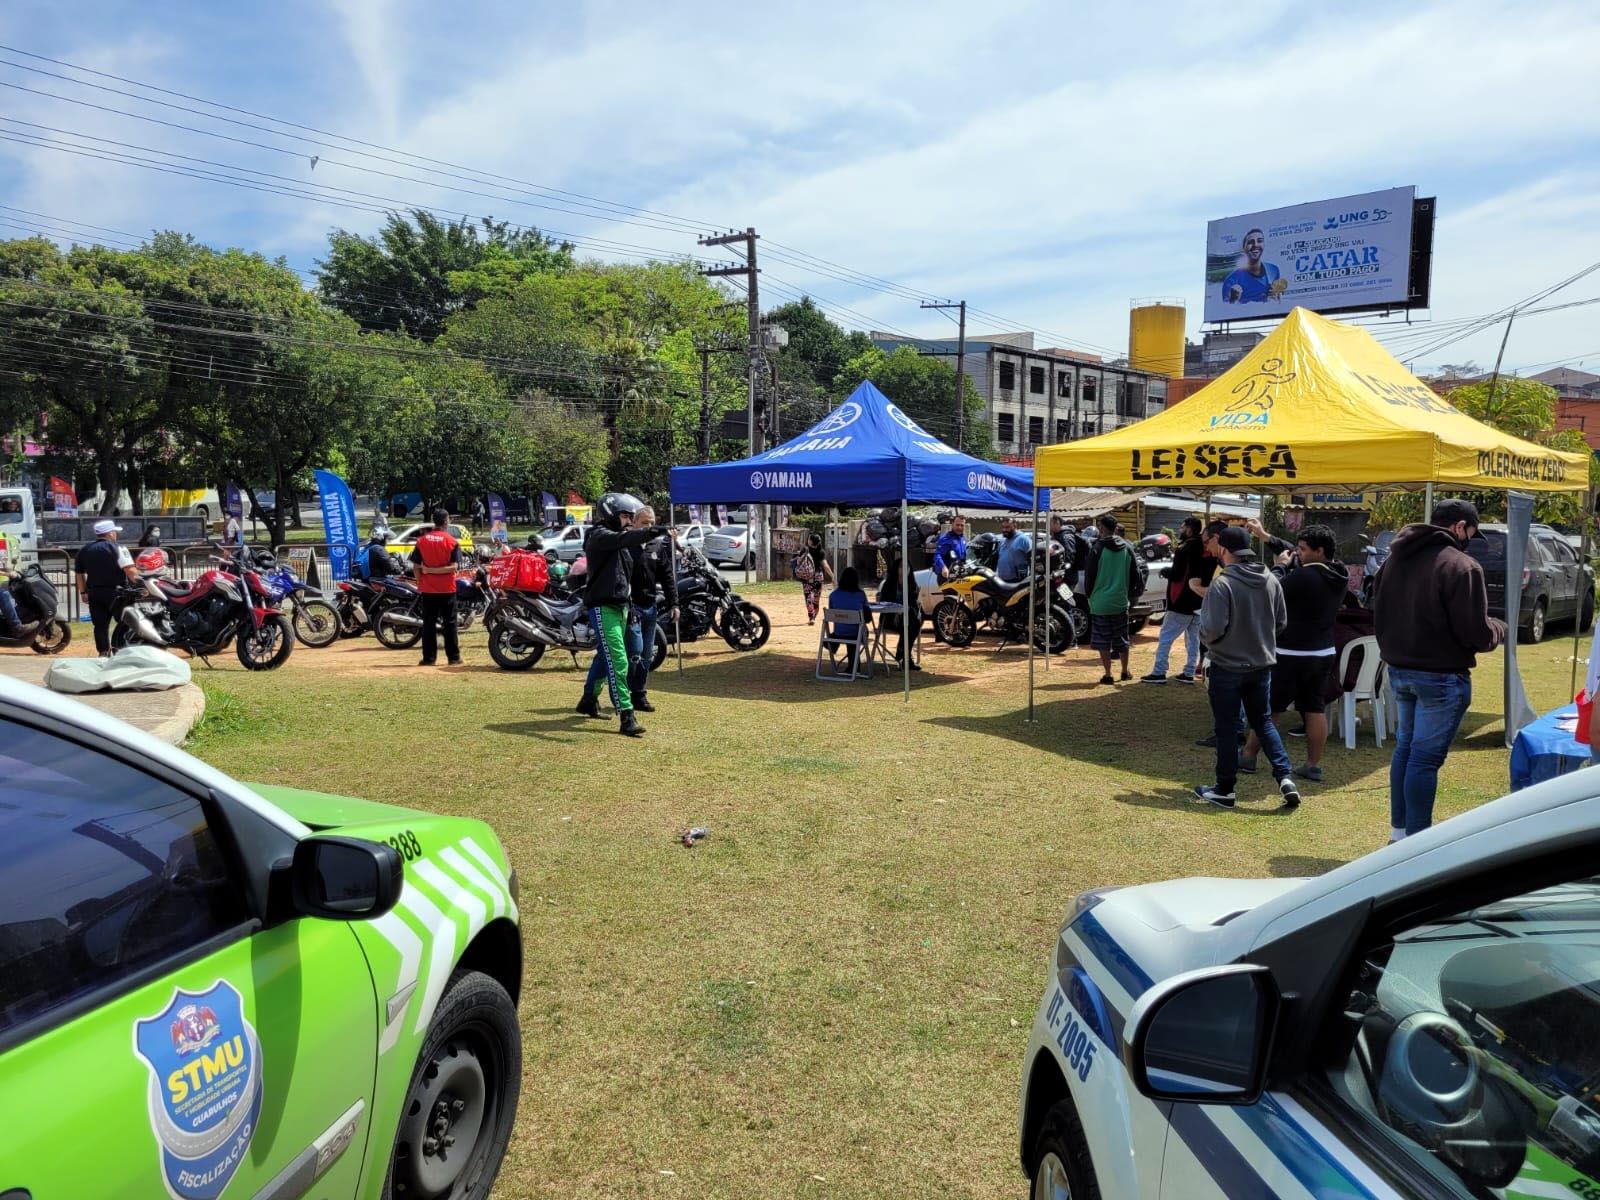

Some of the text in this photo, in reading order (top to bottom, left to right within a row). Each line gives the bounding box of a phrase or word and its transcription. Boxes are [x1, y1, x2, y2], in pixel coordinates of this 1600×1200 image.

[1340, 210, 1369, 224] UNG
[1296, 246, 1380, 272] CATAR
[1295, 271, 1317, 282] COM
[1319, 268, 1347, 279] TUDO
[1211, 411, 1269, 427] VIDA
[763, 436, 853, 460] YAMAHA
[1131, 444, 1298, 481] LEI SECA
[764, 471, 813, 488] YAMAHA
[977, 473, 1007, 493] YAMAHA
[324, 492, 345, 543] YAMAHA
[382, 829, 422, 865] 388
[168, 1035, 244, 1104] STMU
[192, 1091, 238, 1128] GUARULHOS
[177, 1124, 251, 1188] FISCALIZAÇÃO
